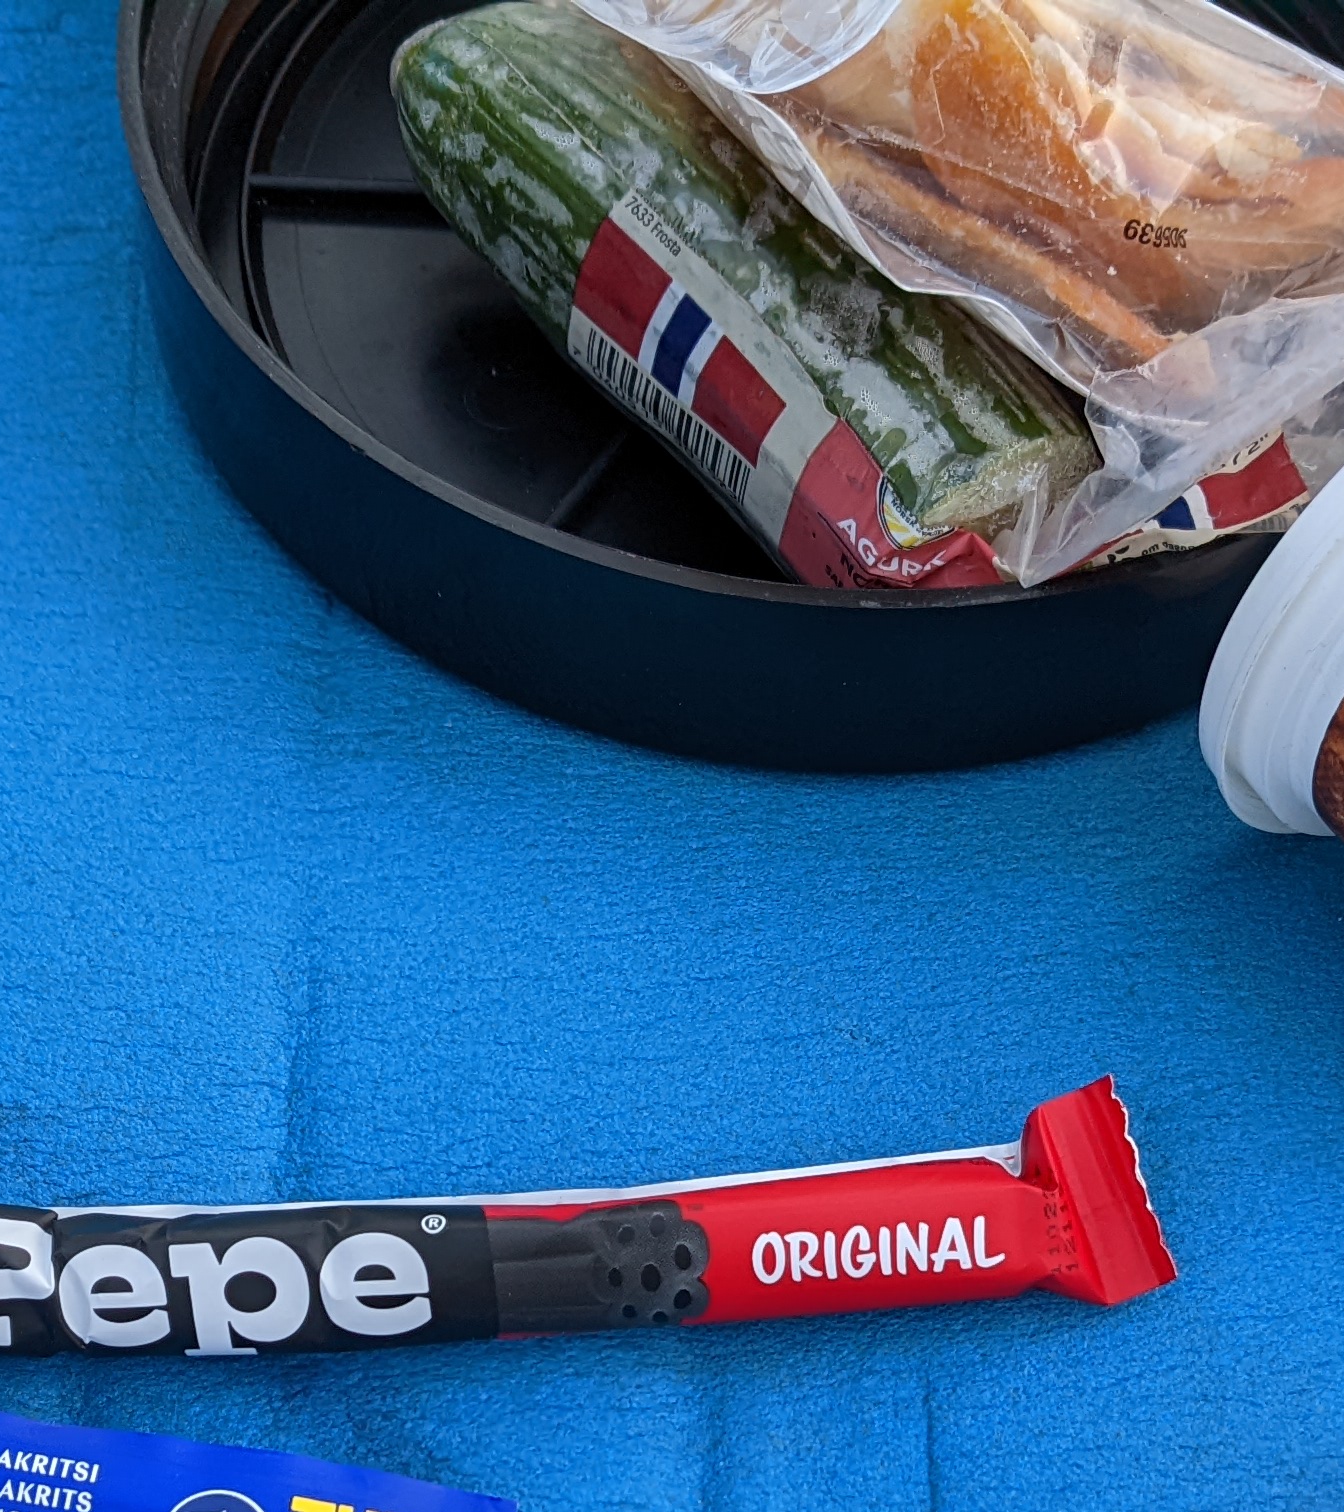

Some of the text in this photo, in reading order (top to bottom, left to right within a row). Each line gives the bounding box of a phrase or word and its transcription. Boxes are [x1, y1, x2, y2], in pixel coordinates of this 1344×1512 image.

[624, 195, 654, 228] 7633
[651, 222, 682, 258] Frosta
[836, 517, 951, 577] AGURK
[750, 1213, 1006, 1286] ORIGINAL
